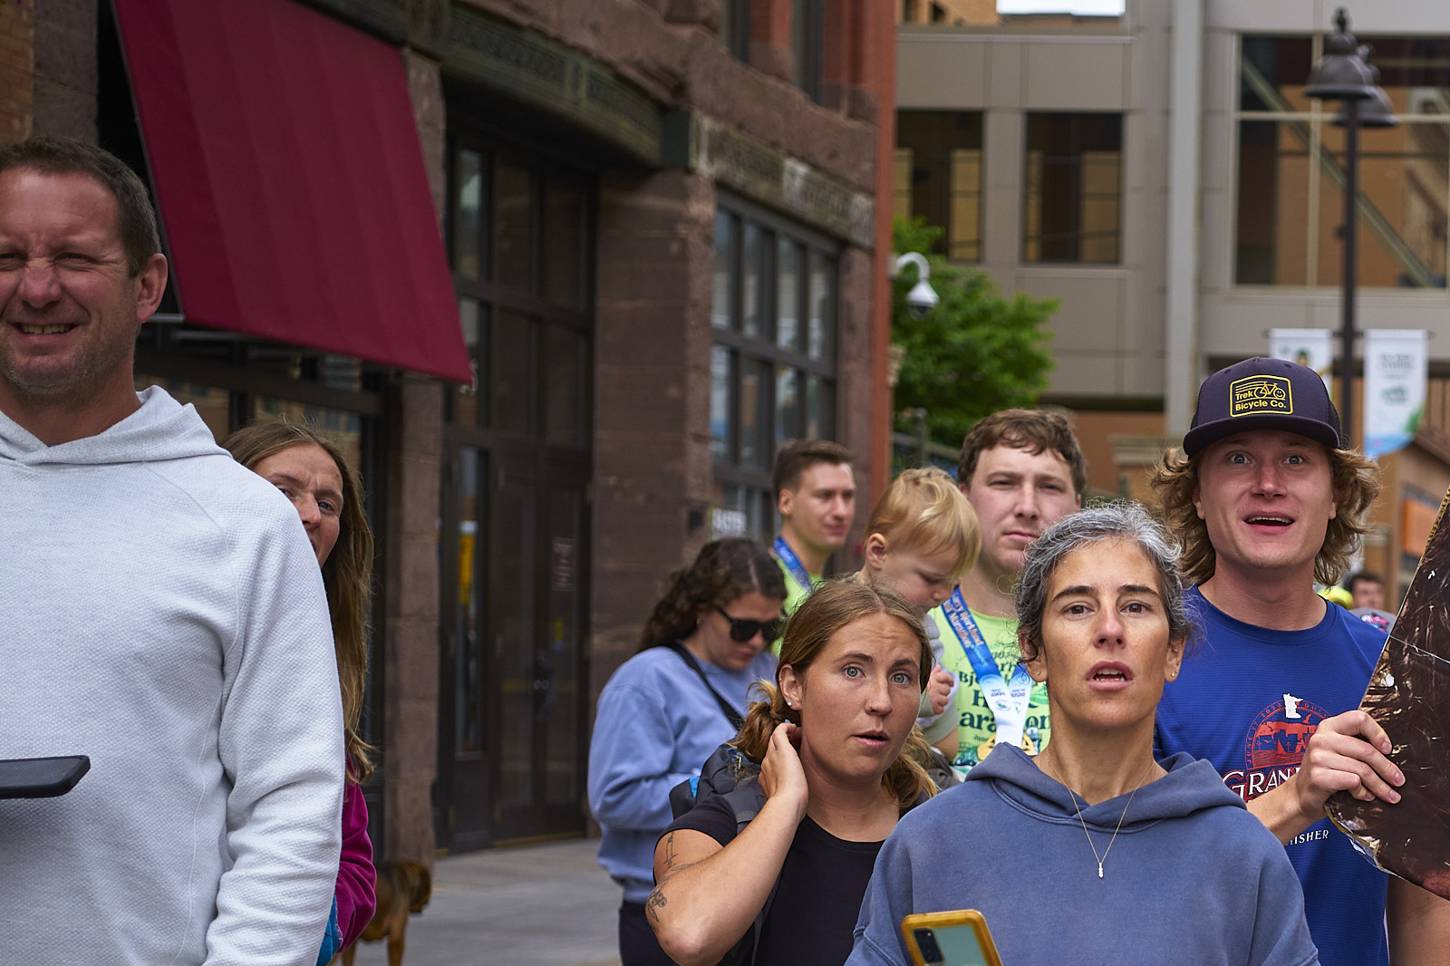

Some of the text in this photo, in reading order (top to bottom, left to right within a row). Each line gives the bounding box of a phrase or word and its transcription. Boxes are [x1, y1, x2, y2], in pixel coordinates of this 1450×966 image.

[1235, 390, 1253, 400] Trek
[1235, 399, 1287, 411] Bicycle Co.
